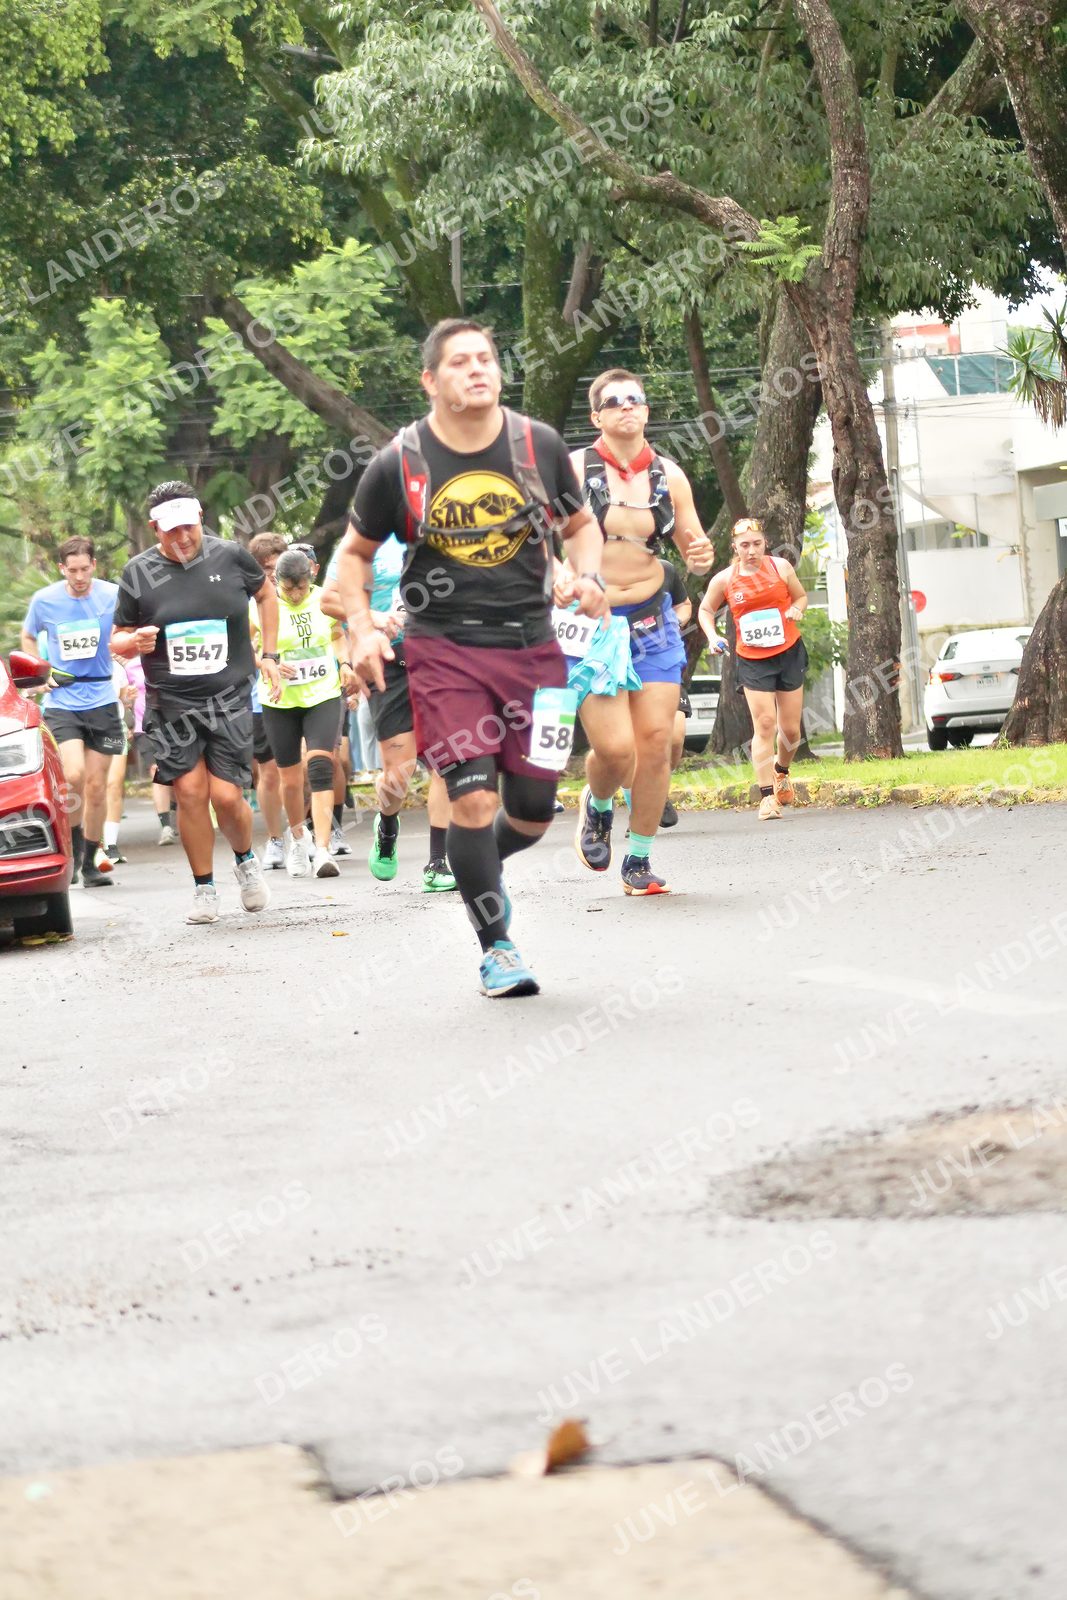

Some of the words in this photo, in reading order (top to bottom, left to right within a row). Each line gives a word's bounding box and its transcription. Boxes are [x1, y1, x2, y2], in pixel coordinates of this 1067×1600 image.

[431, 503, 477, 528] SAN
[290, 612, 312, 625] JUST
[297, 624, 312, 637] DO
[554, 621, 590, 643] 601
[745, 625, 781, 642] 3842
[63, 636, 98, 650] 5428
[302, 637, 311, 648] IT
[173, 644, 223, 662] 5547
[289, 664, 327, 681] 146
[539, 726, 573, 750] 58
